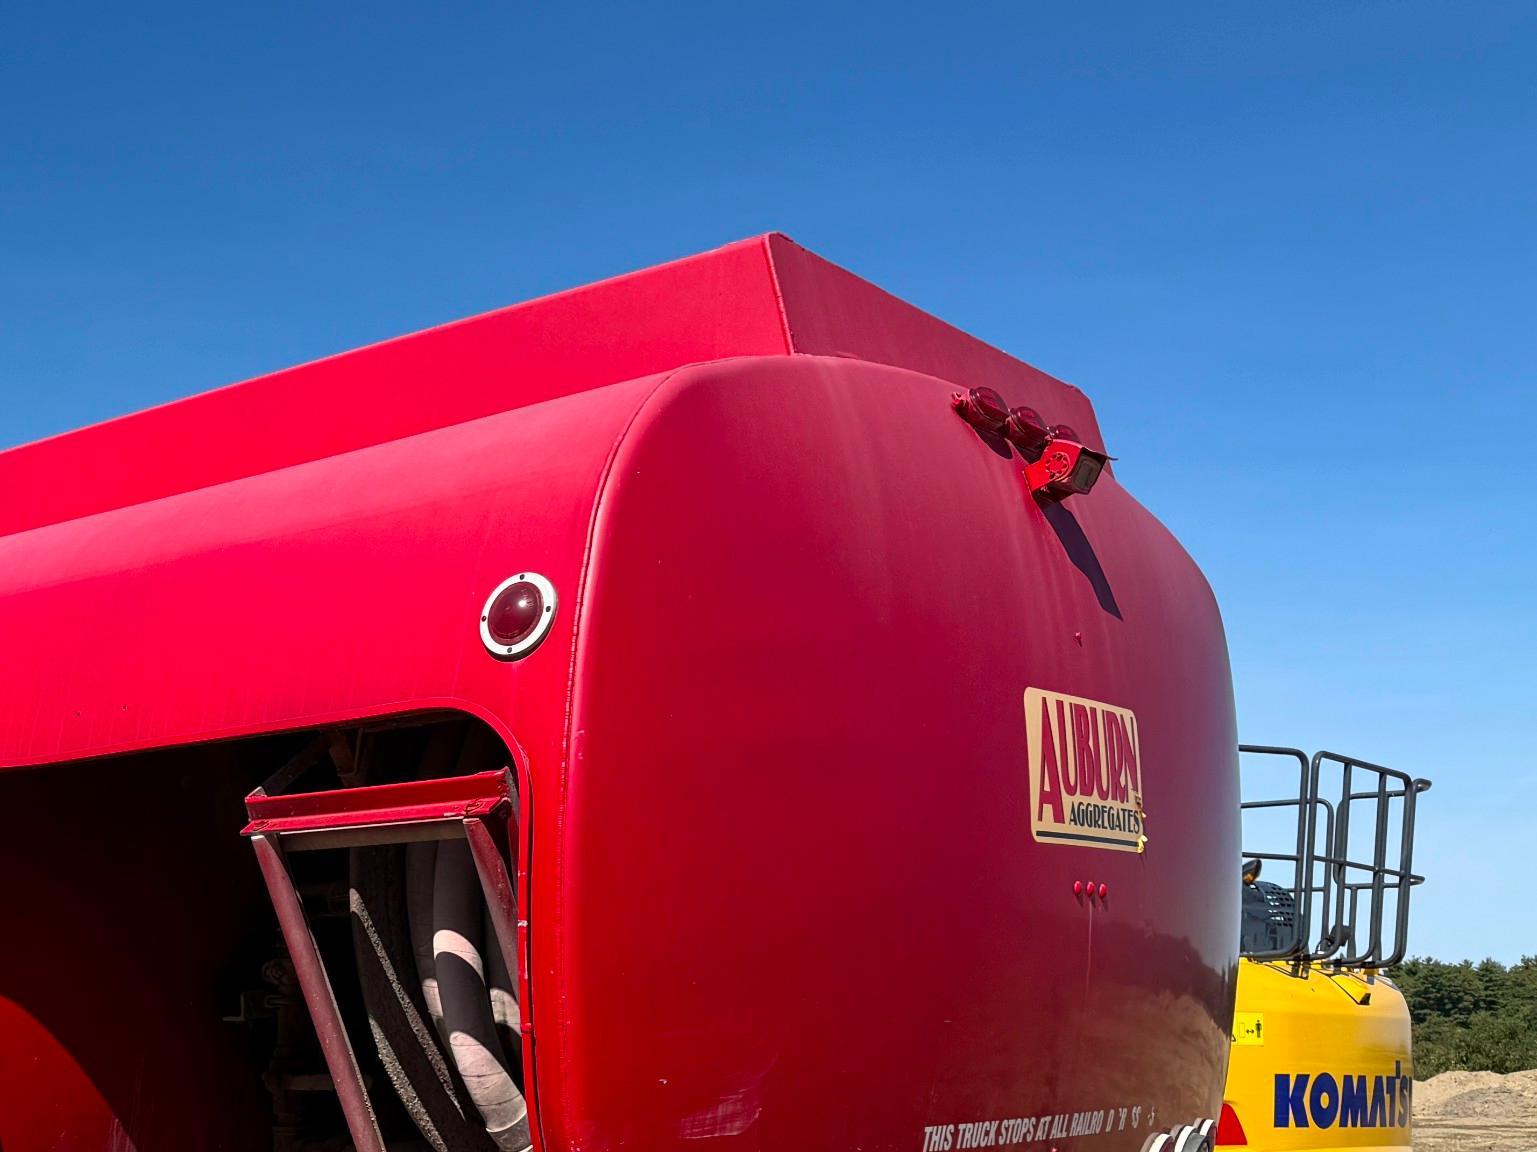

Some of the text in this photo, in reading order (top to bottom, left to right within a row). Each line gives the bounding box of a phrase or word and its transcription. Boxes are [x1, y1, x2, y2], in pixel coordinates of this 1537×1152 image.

[1037, 696, 1139, 825] AUBURN
[1069, 801, 1140, 834] AGGREGATES
[923, 1124, 955, 1152] THIS
[956, 1120, 999, 1149] TRUCK
[999, 1117, 1036, 1145] STOPS
[1034, 1116, 1052, 1140] AT
[1049, 1114, 1069, 1139] ALL
